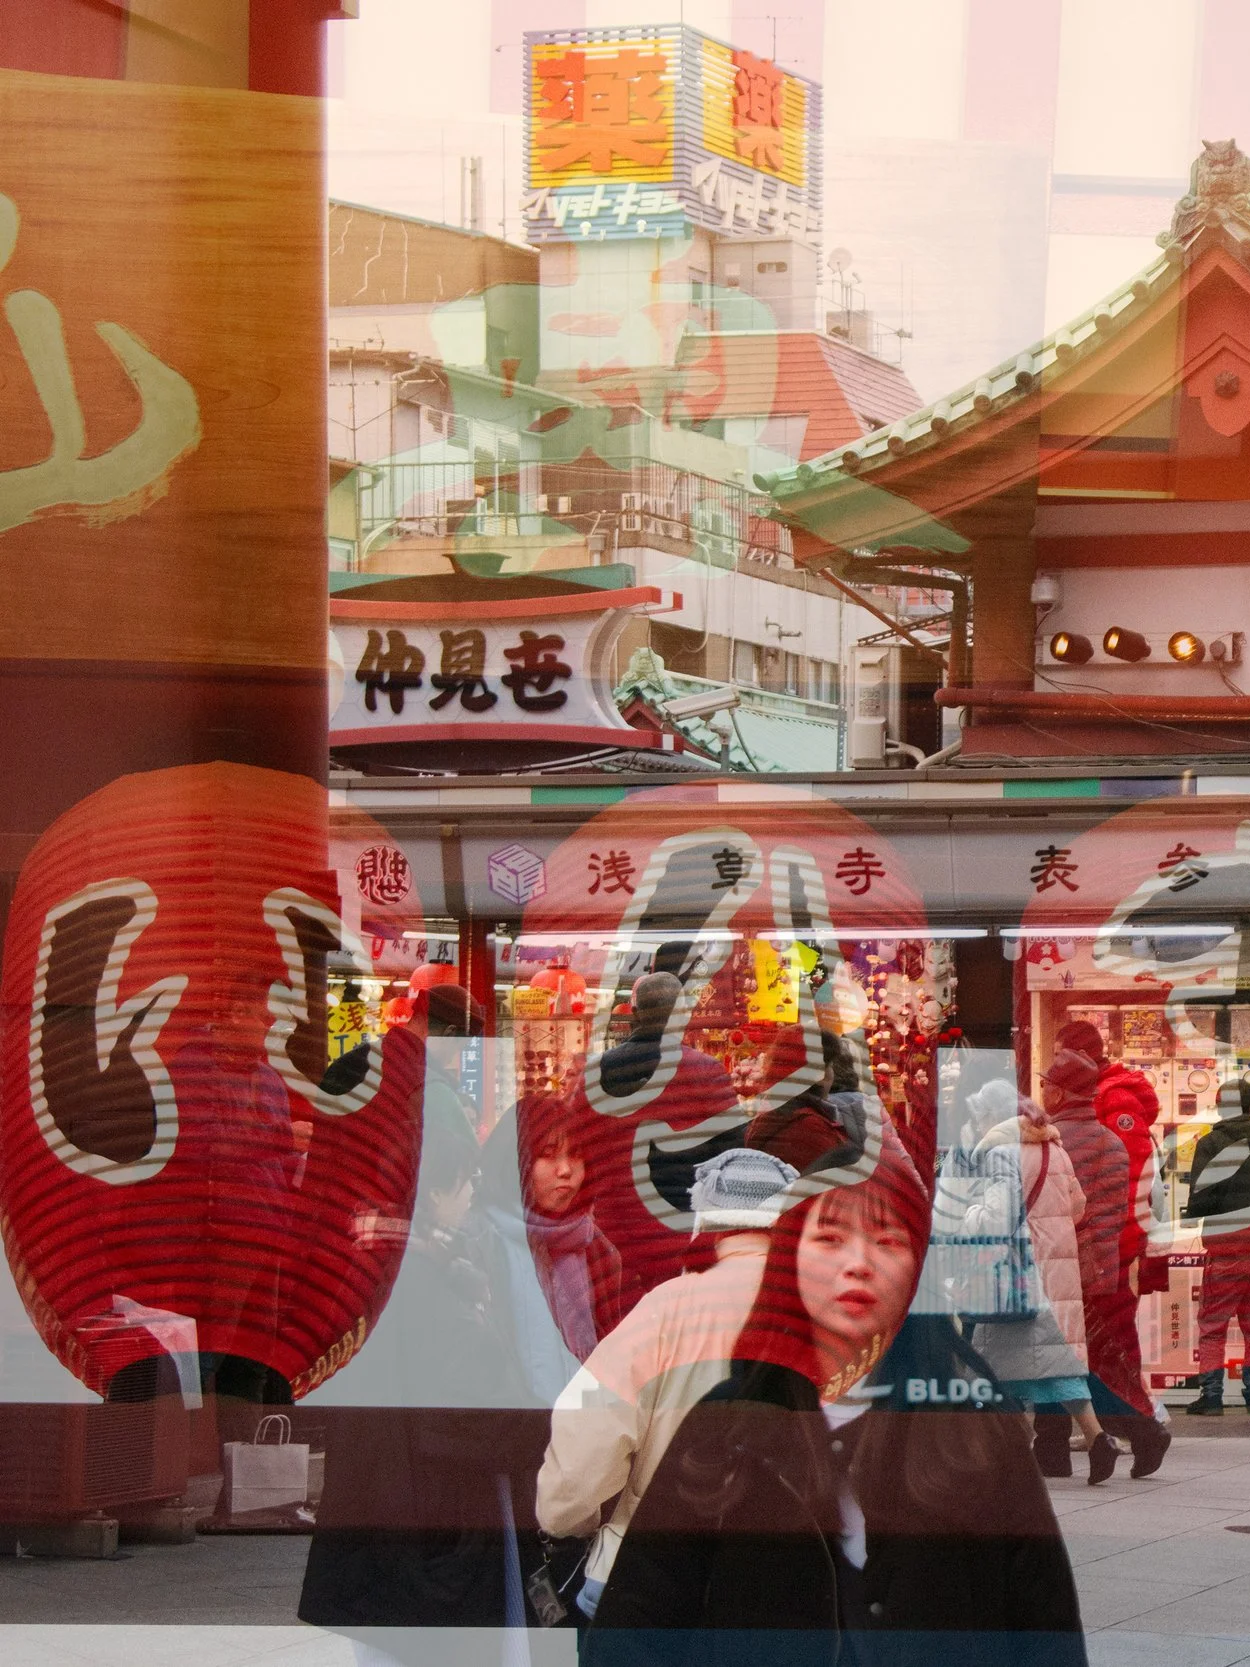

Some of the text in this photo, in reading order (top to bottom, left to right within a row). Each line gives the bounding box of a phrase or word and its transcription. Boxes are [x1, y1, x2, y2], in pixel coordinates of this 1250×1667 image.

[535, 49, 668, 173] 薬
[731, 50, 785, 172] 薬
[355, 629, 573, 715] 仲見世
[587, 846, 887, 897] 浅草寺
[906, 1377, 1003, 1403] BLDG.
